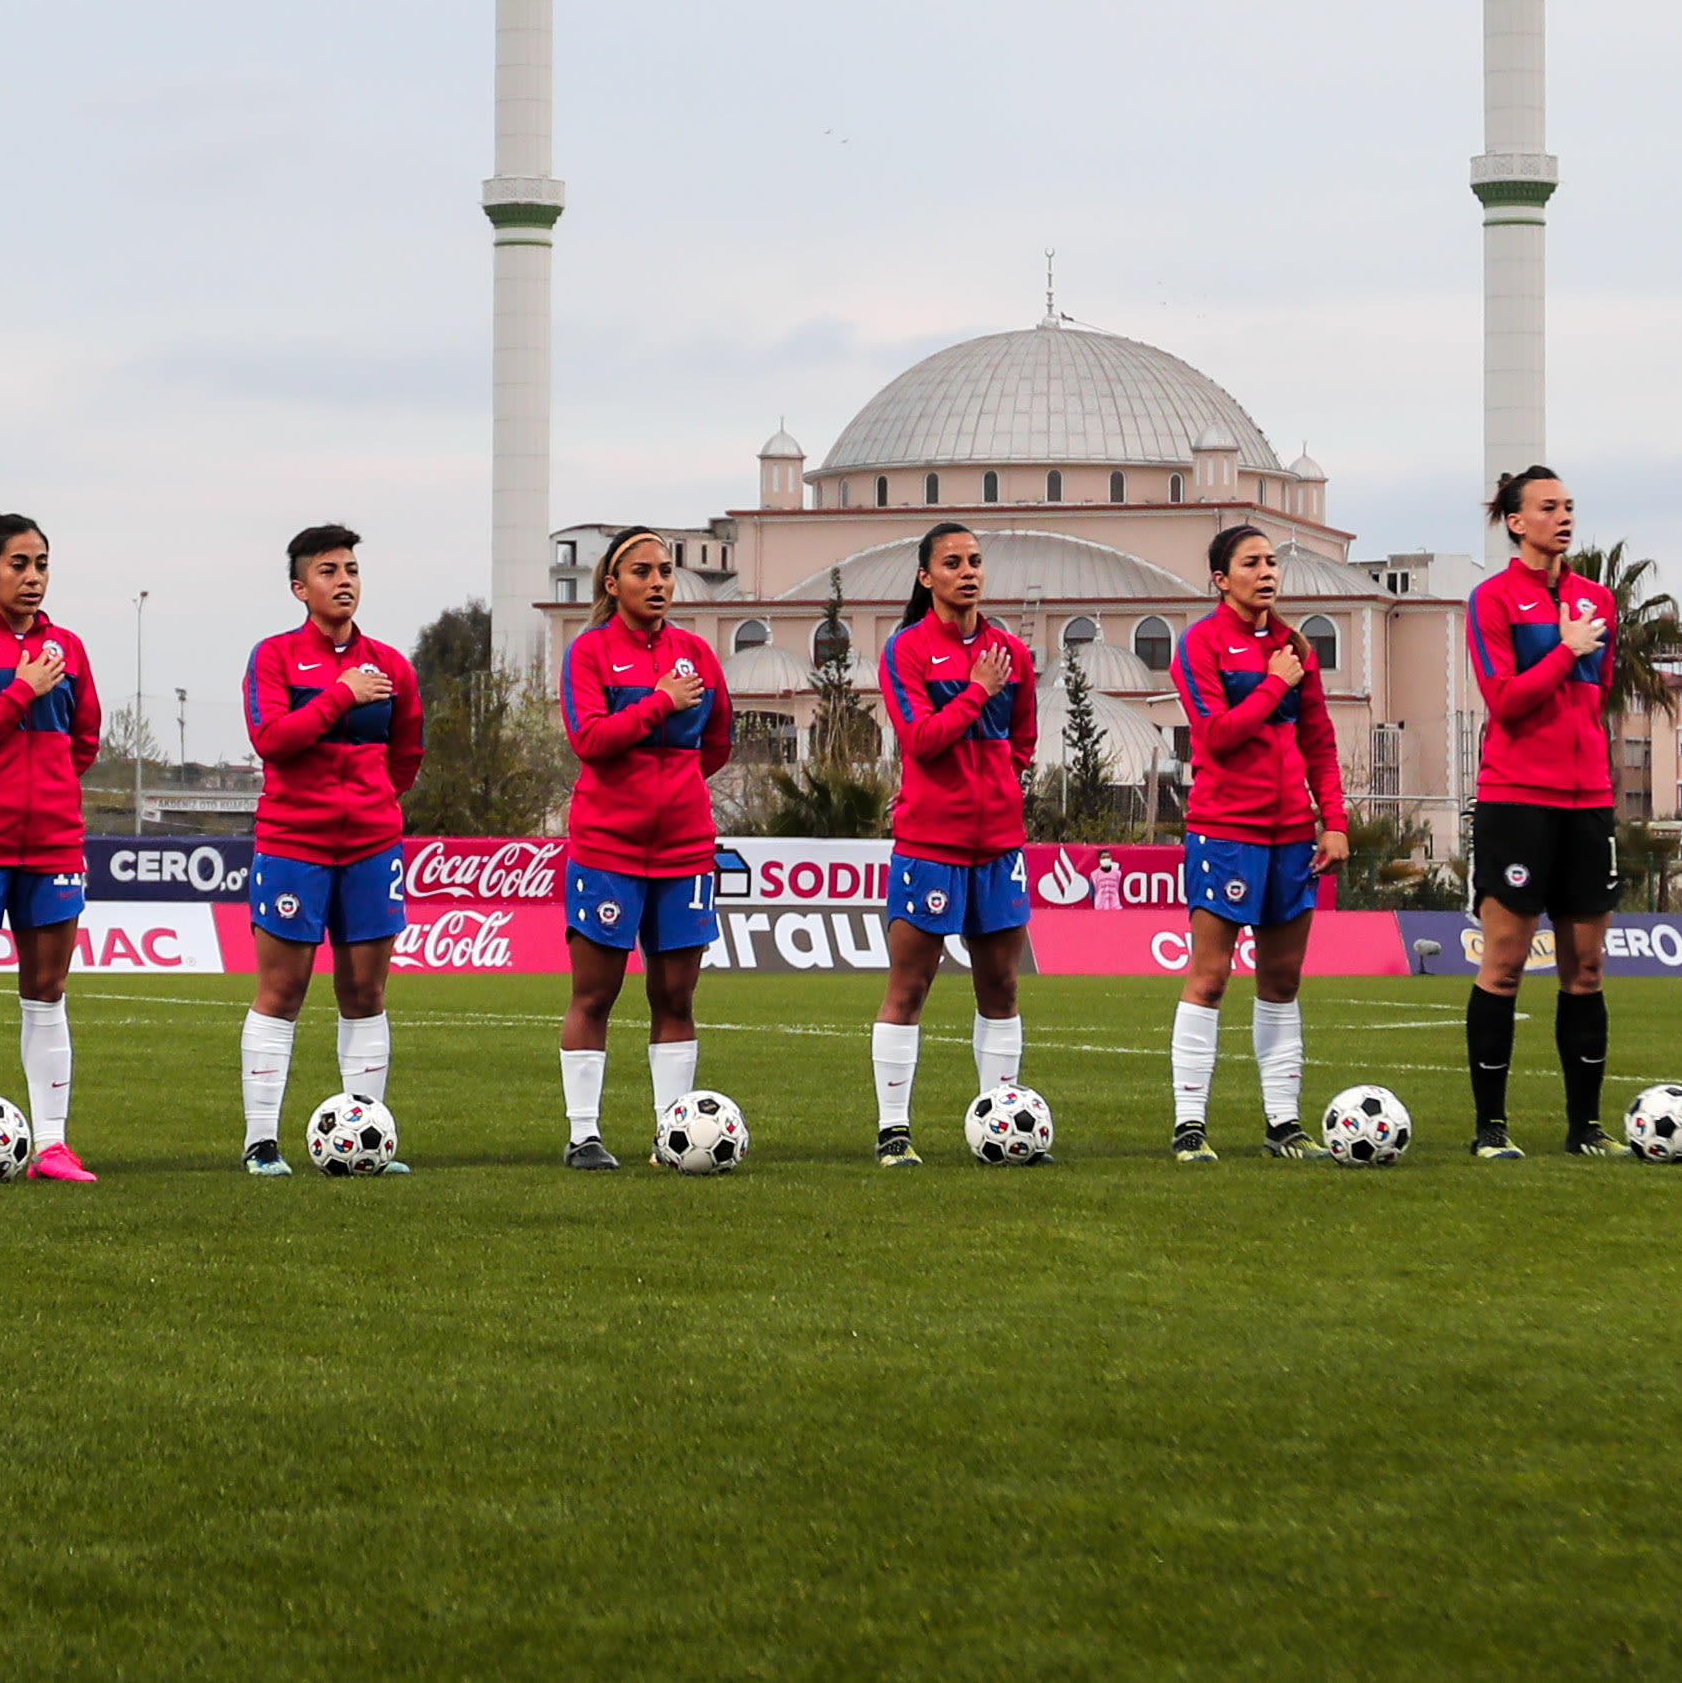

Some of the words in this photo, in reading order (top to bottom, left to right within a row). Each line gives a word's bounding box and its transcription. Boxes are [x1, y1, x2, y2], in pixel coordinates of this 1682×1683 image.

[406, 841, 564, 898] Coca-Cola
[1011, 852, 1027, 893] 4
[390, 910, 514, 967] a-Cola
